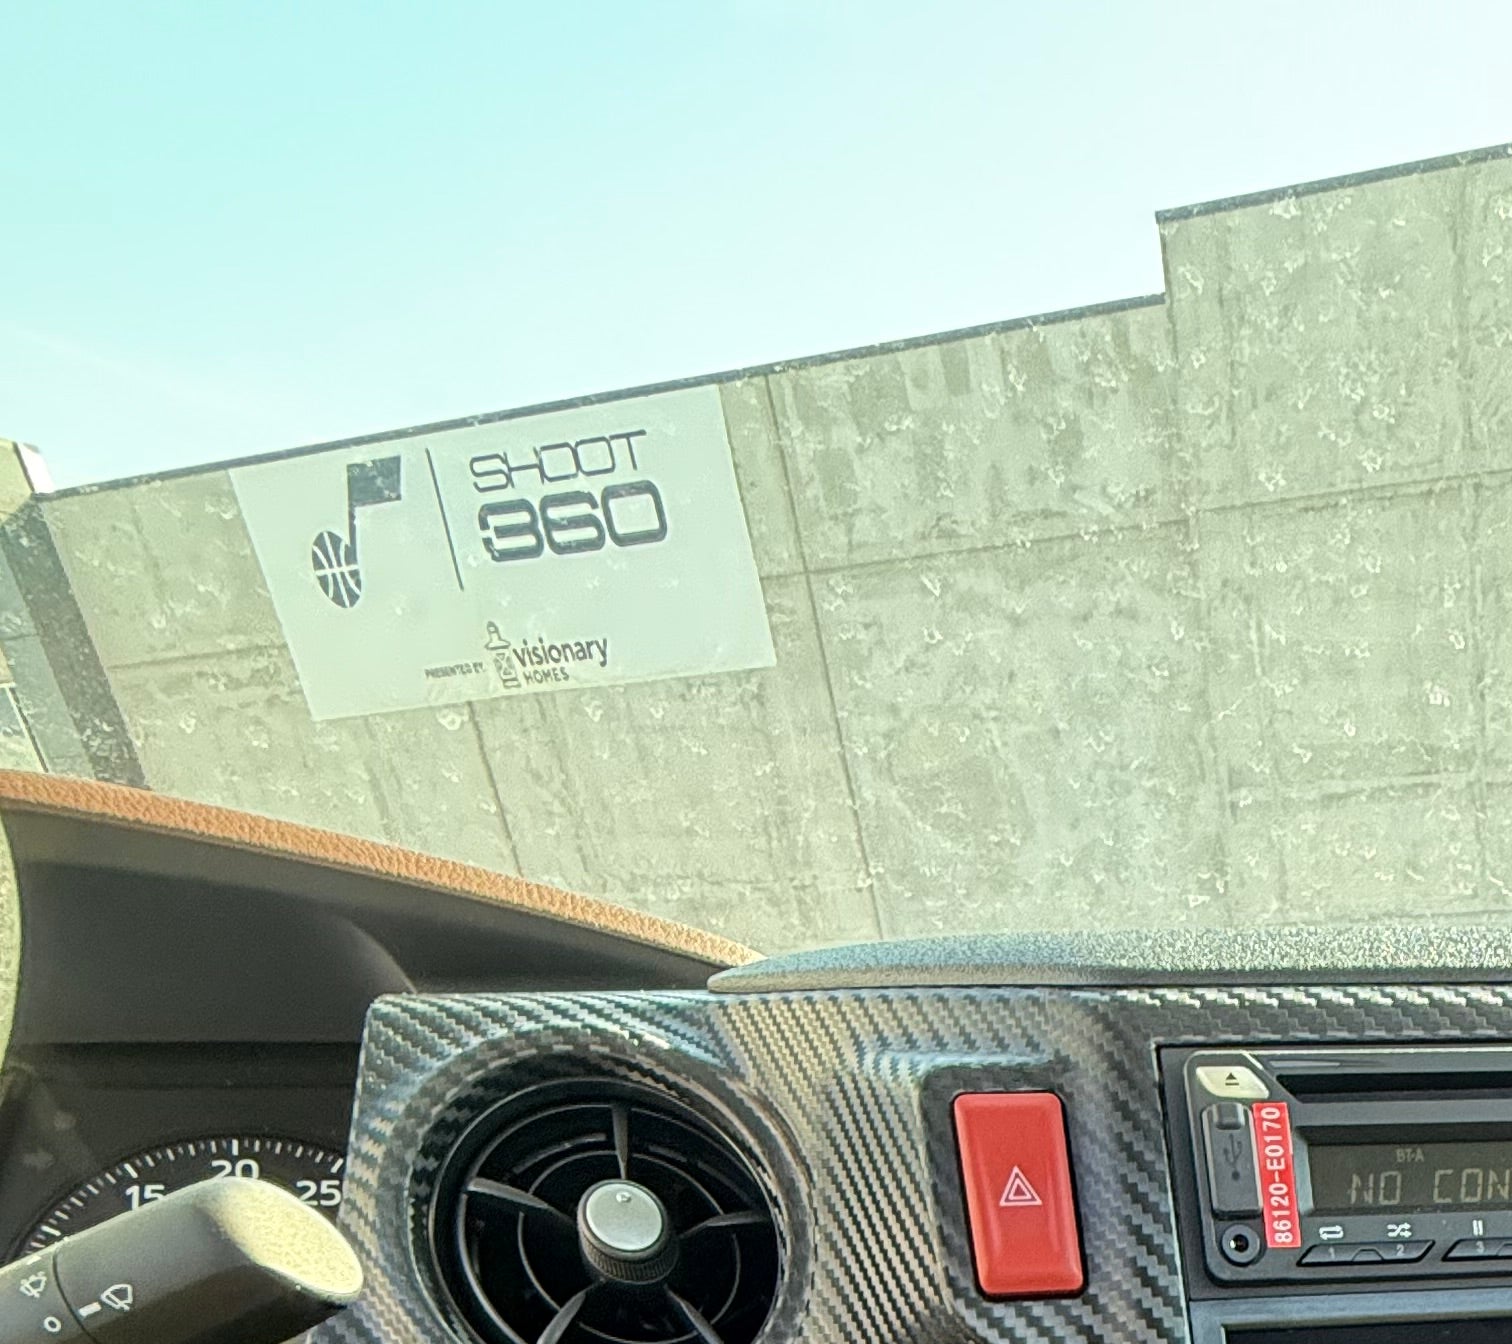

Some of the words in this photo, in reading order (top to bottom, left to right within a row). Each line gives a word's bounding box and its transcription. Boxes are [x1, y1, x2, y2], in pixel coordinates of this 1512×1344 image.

[470, 430, 646, 492] SHOOT
[478, 480, 667, 562] 360
[523, 666, 570, 685] HOMES
[1261, 1107, 1293, 1243] 86120-E0170
[1350, 1171, 1402, 1205] NO
[296, 1179, 342, 1206] 25
[1328, 1247, 1336, 1259] 1
[1396, 1244, 1405, 1256] 2
[1476, 1241, 1485, 1253] 3
